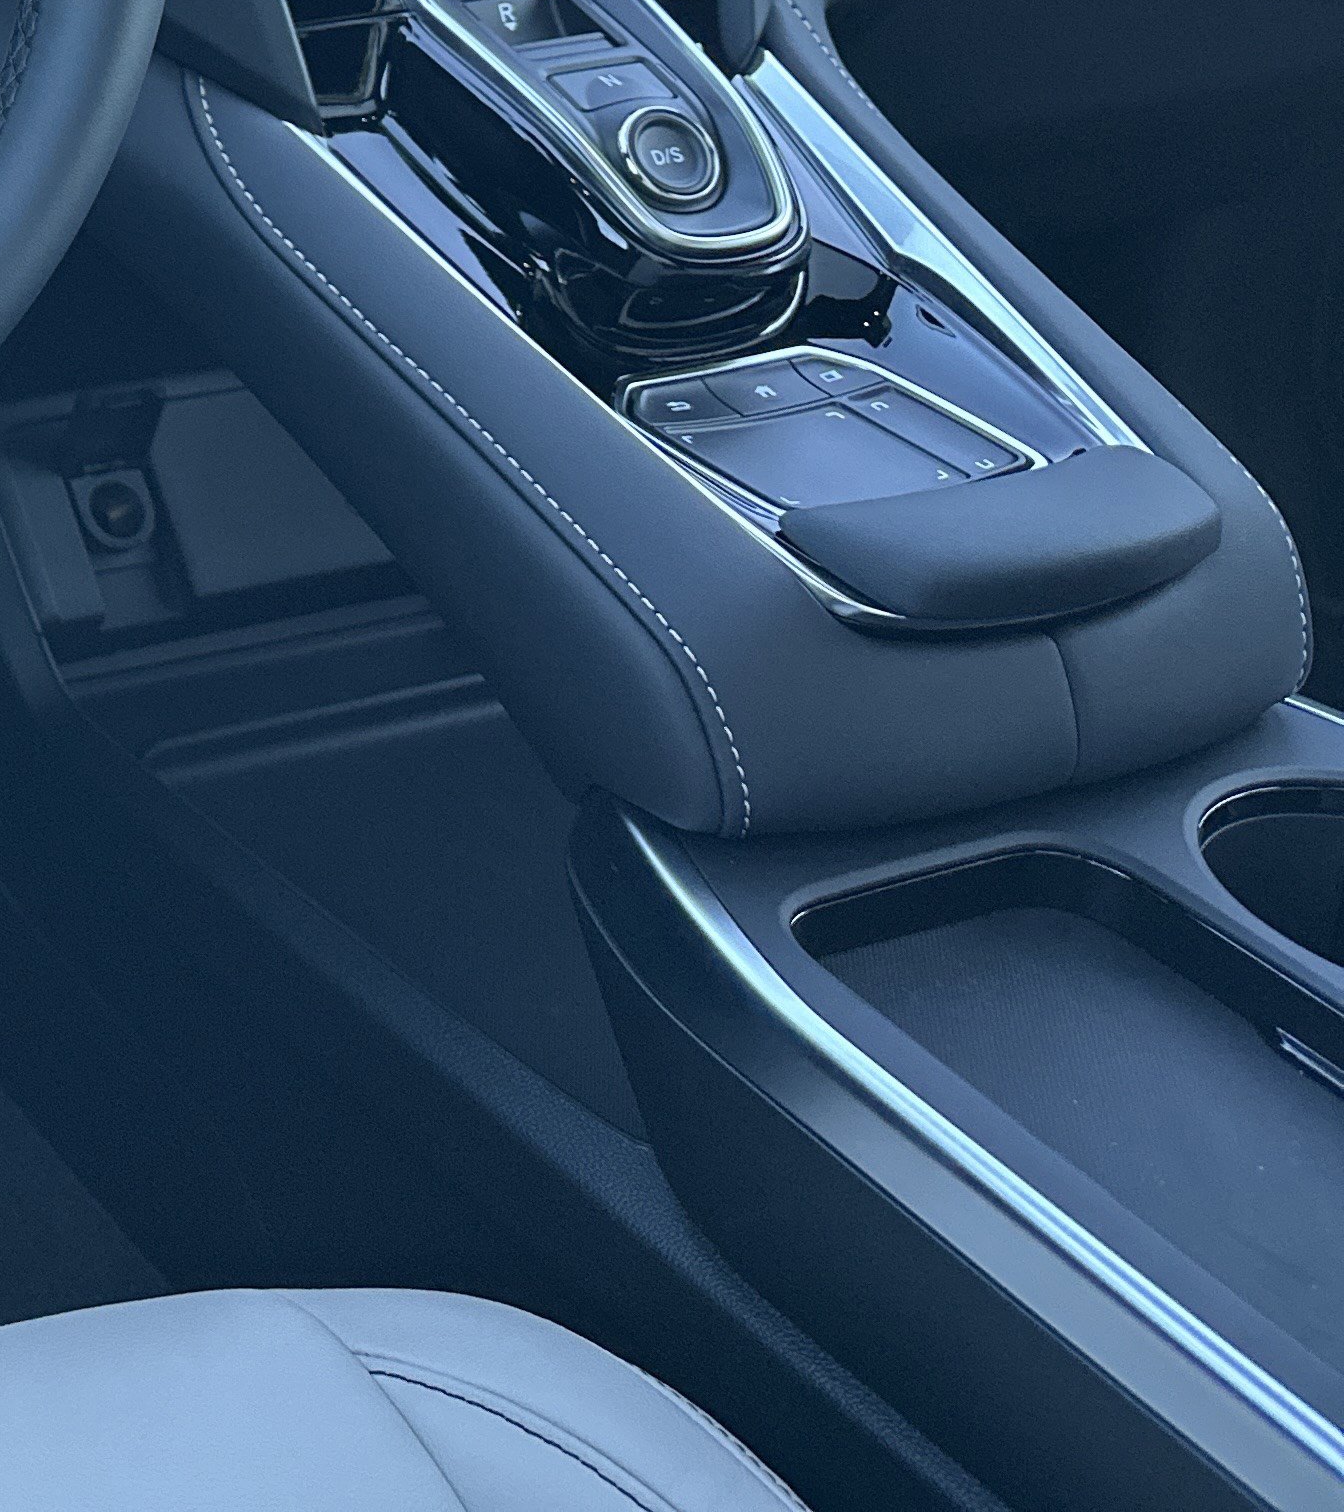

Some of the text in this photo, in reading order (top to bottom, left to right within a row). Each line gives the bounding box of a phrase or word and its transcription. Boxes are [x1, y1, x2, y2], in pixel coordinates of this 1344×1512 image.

[498, 2, 516, 23] R
[598, 73, 623, 87] N
[650, 147, 685, 166] D/S
